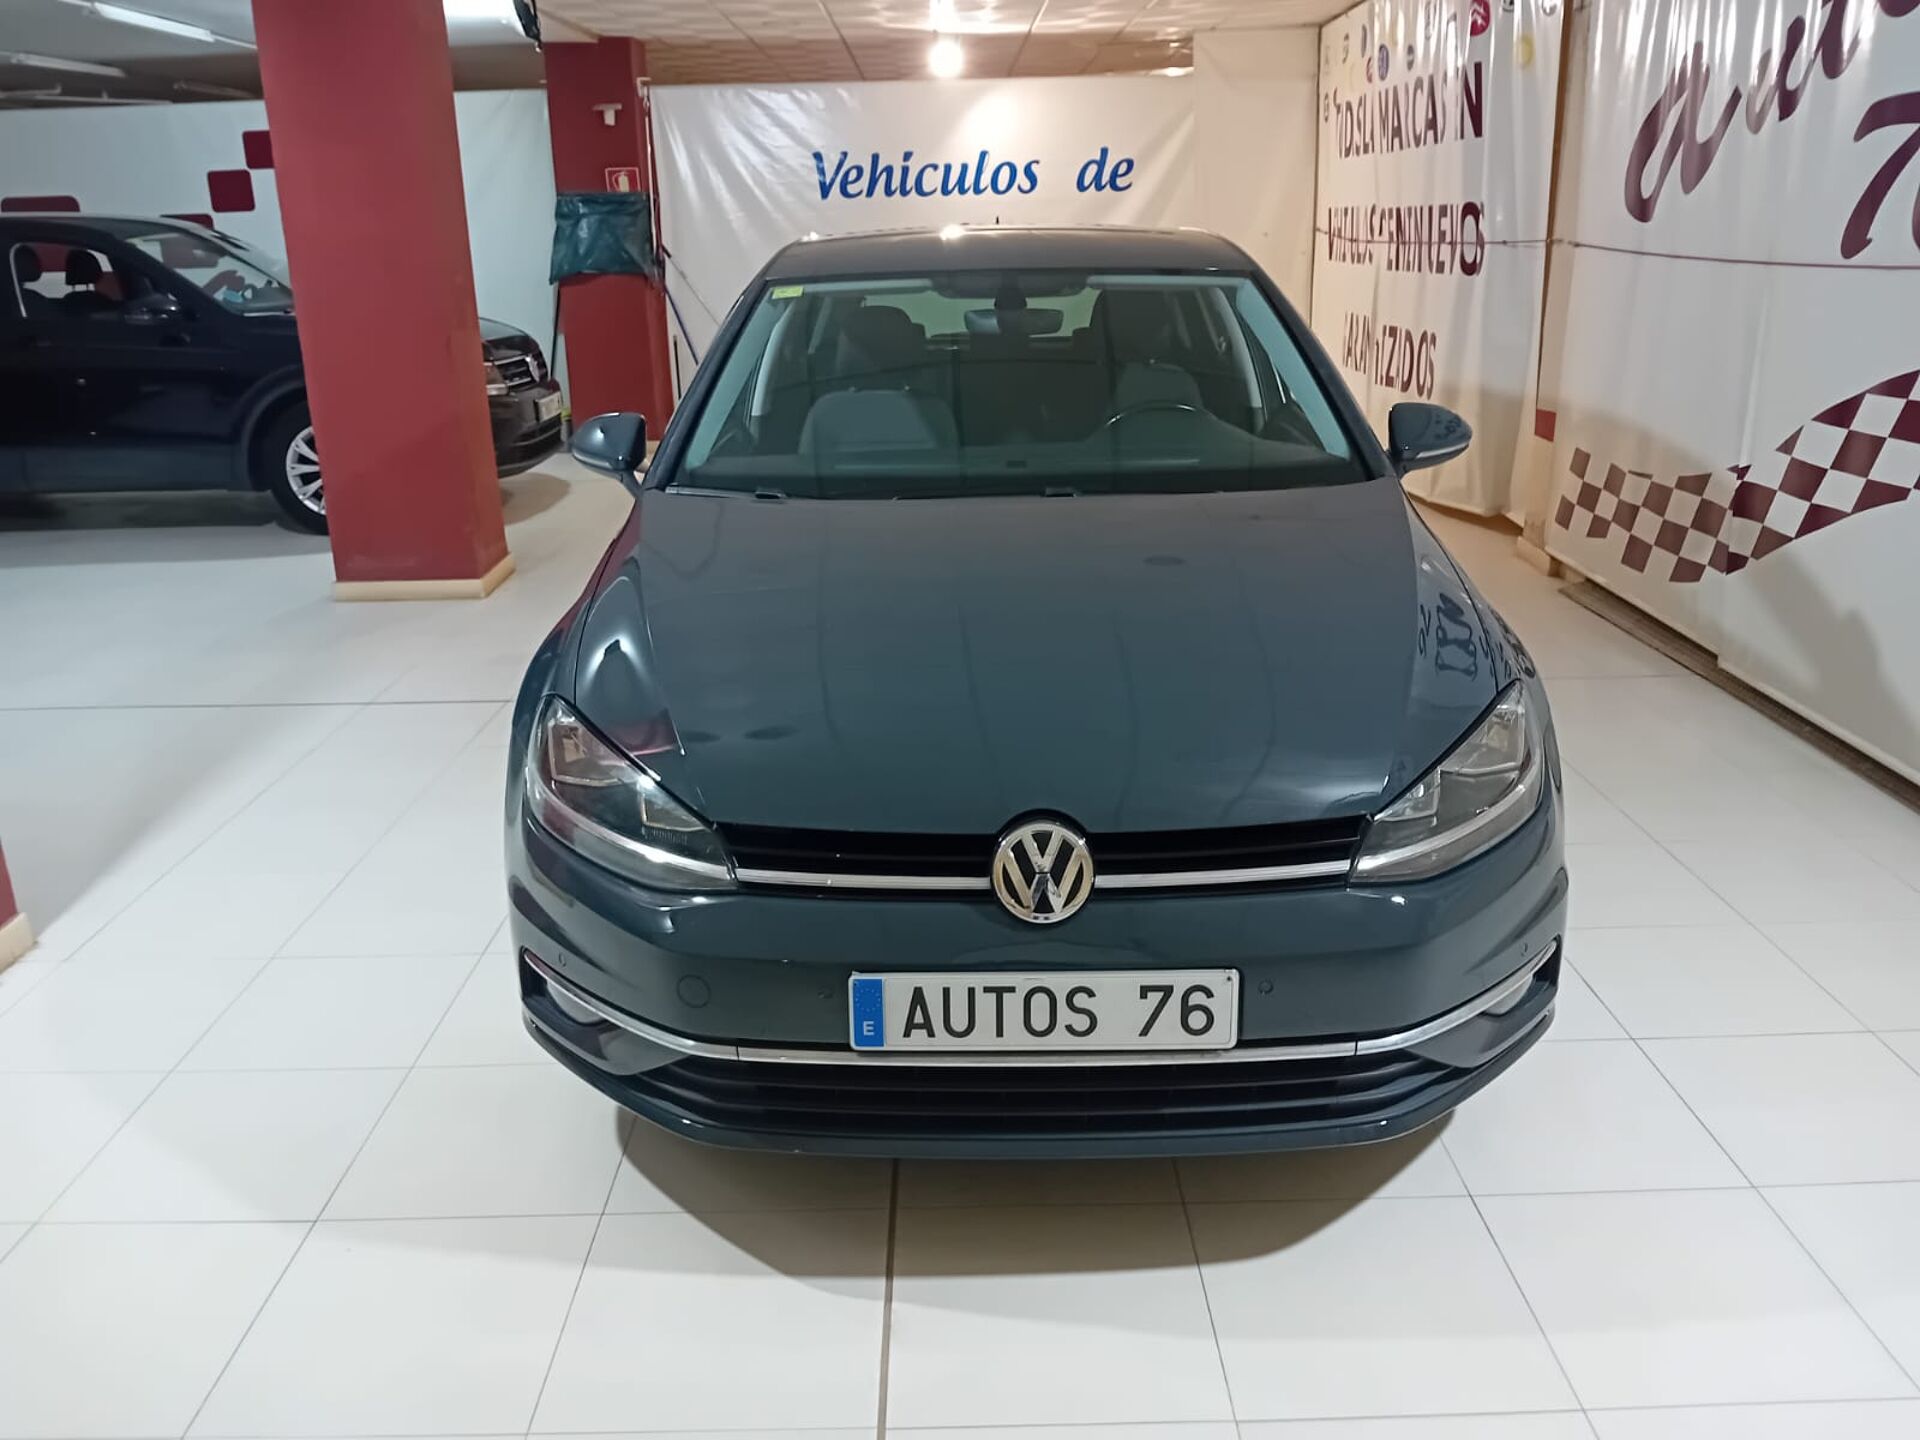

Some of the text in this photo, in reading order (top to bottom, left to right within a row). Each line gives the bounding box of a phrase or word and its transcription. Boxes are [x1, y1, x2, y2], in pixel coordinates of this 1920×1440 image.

[1076, 147, 1134, 193] de
[1841, 91, 1920, 260] 7
[863, 984, 1215, 1038] E AUTOS 76
